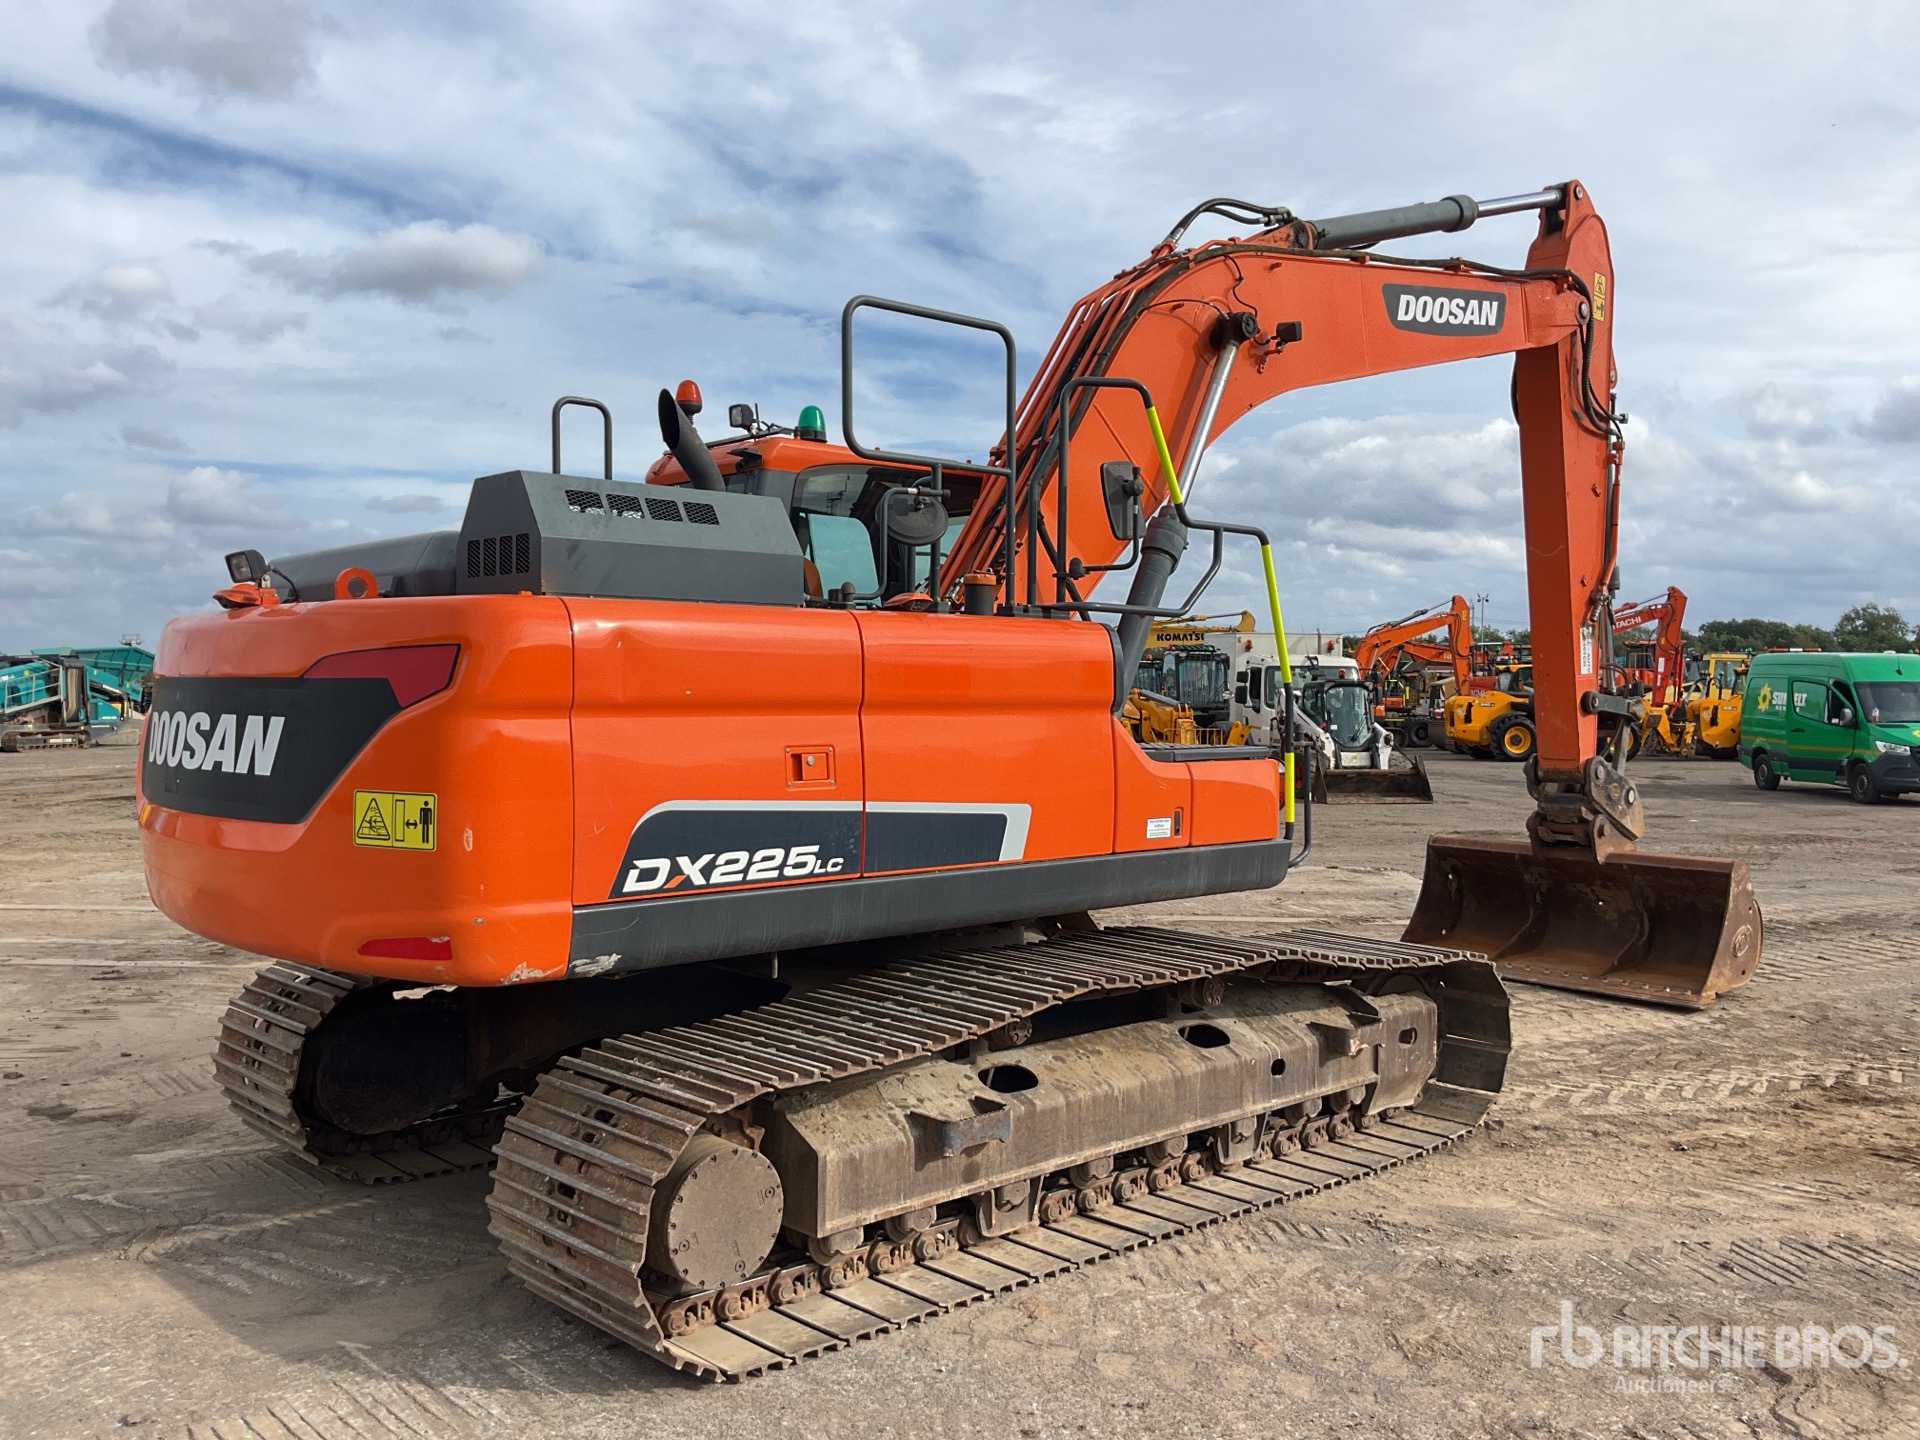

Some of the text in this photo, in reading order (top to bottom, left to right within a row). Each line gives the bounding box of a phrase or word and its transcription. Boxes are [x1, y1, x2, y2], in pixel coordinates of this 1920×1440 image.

[1397, 294, 1498, 327] DOOSAN
[1612, 616, 1642, 630] ITACHI
[1772, 692, 1808, 706] SUELT
[147, 710, 286, 776] DOOSAN
